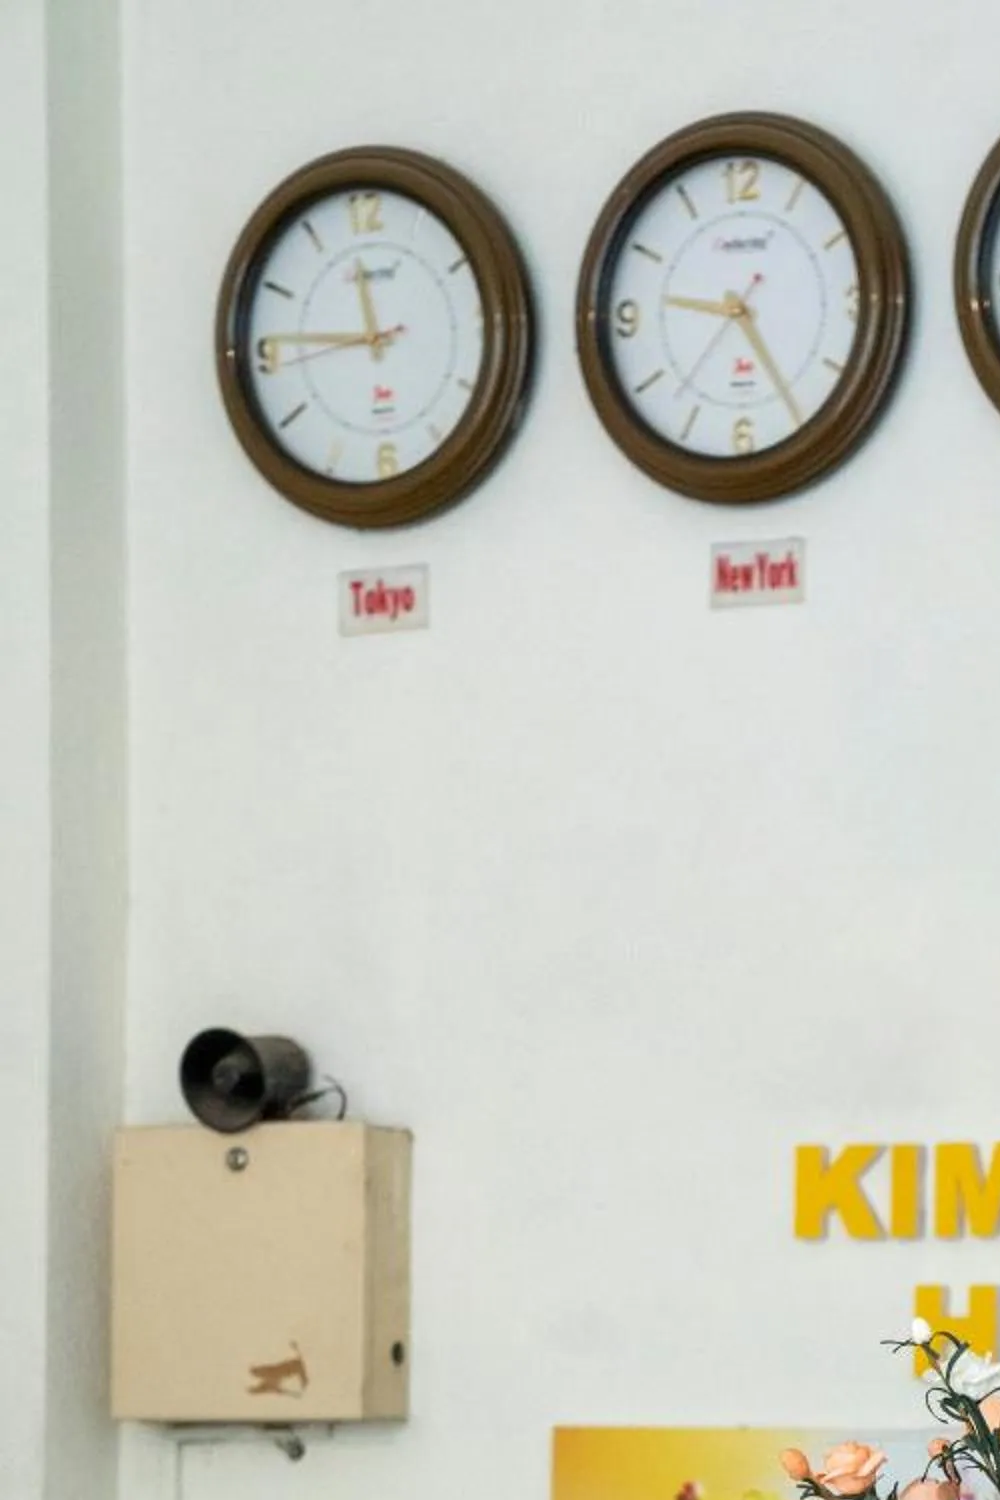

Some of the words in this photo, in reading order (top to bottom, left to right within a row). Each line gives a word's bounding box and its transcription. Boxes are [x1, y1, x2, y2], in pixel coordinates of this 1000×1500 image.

[724, 158, 760, 204] 12
[349, 191, 384, 234] 12
[616, 299, 639, 338] 9
[258, 336, 278, 374] 9
[733, 416, 754, 453] 6
[377, 441, 398, 478] 6
[350, 579, 416, 622] Tokyo
